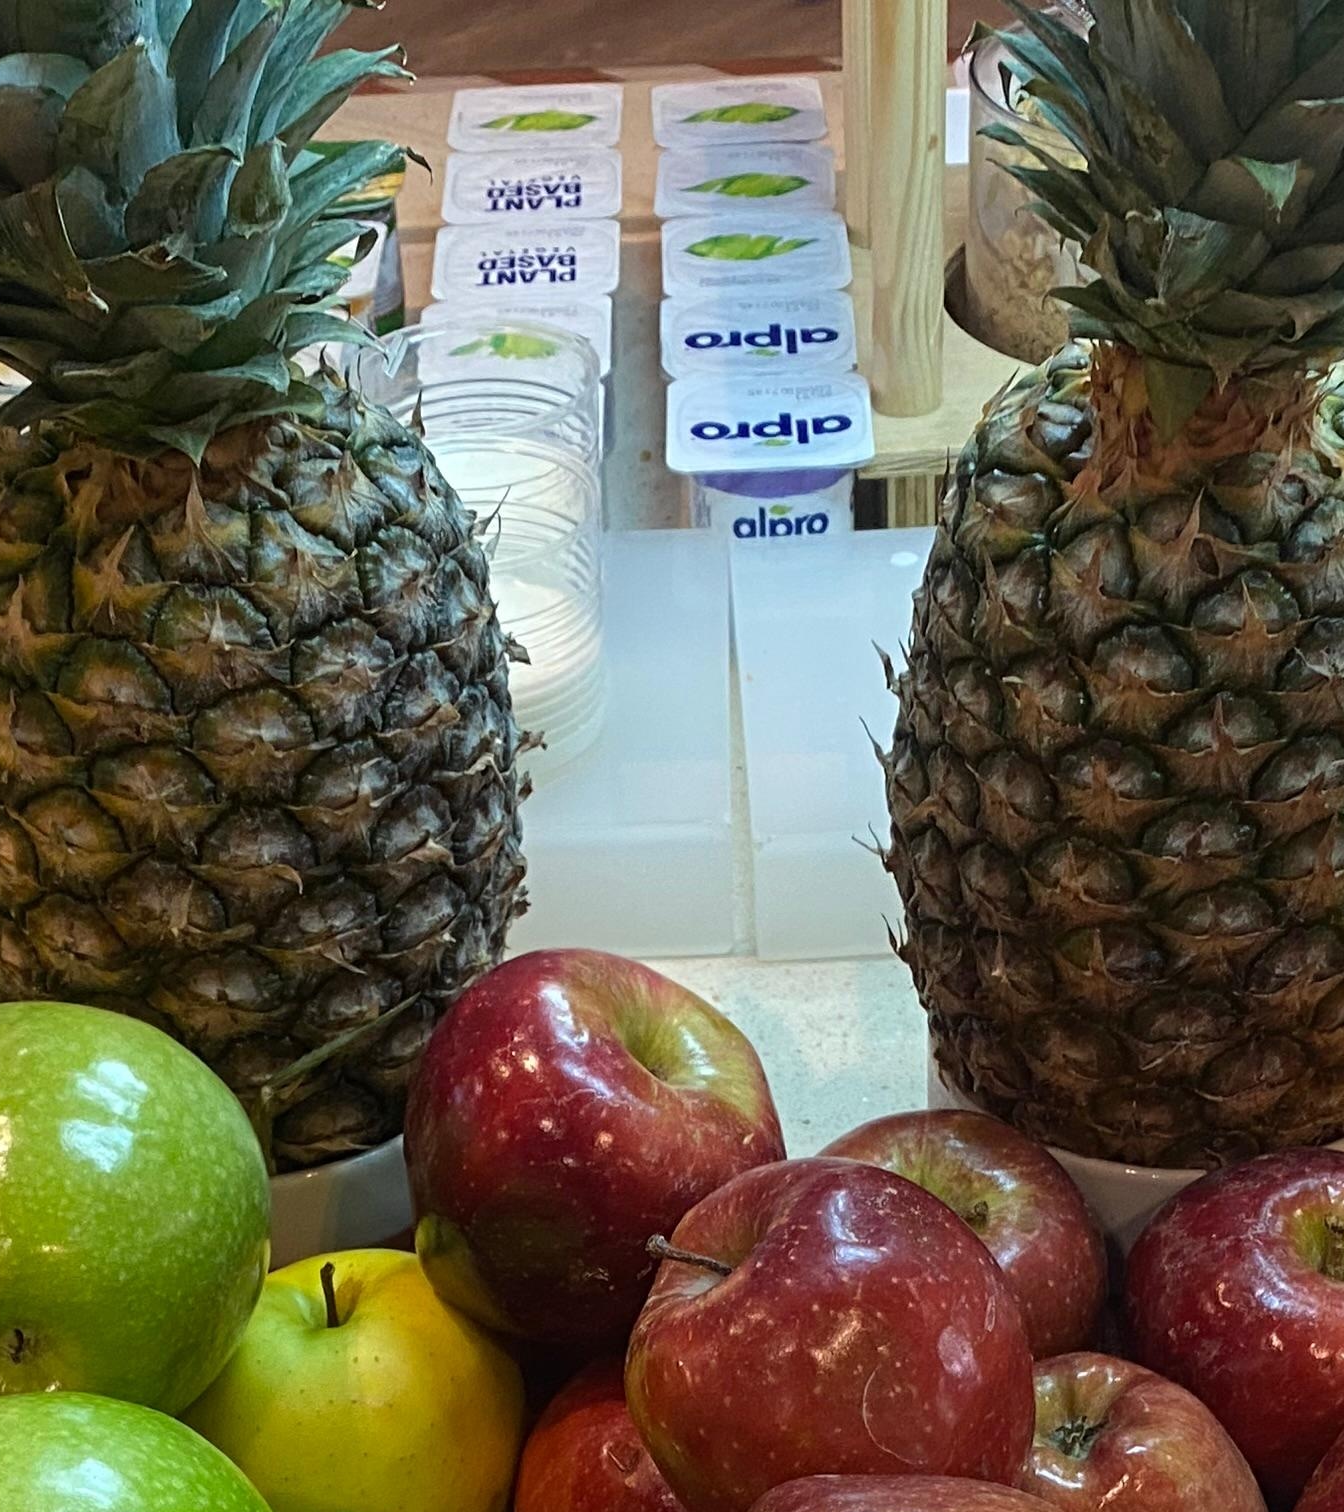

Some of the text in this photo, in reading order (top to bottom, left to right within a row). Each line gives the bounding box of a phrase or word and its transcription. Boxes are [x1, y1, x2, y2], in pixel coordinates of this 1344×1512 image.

[486, 182, 582, 198] BASED
[484, 196, 582, 212] PLANT
[479, 247, 575, 257] VEGETAL
[477, 253, 576, 271] BASED
[476, 268, 576, 286] PLANT
[685, 323, 838, 355] alpro
[690, 412, 852, 445] alpro
[732, 506, 830, 539] alpro
